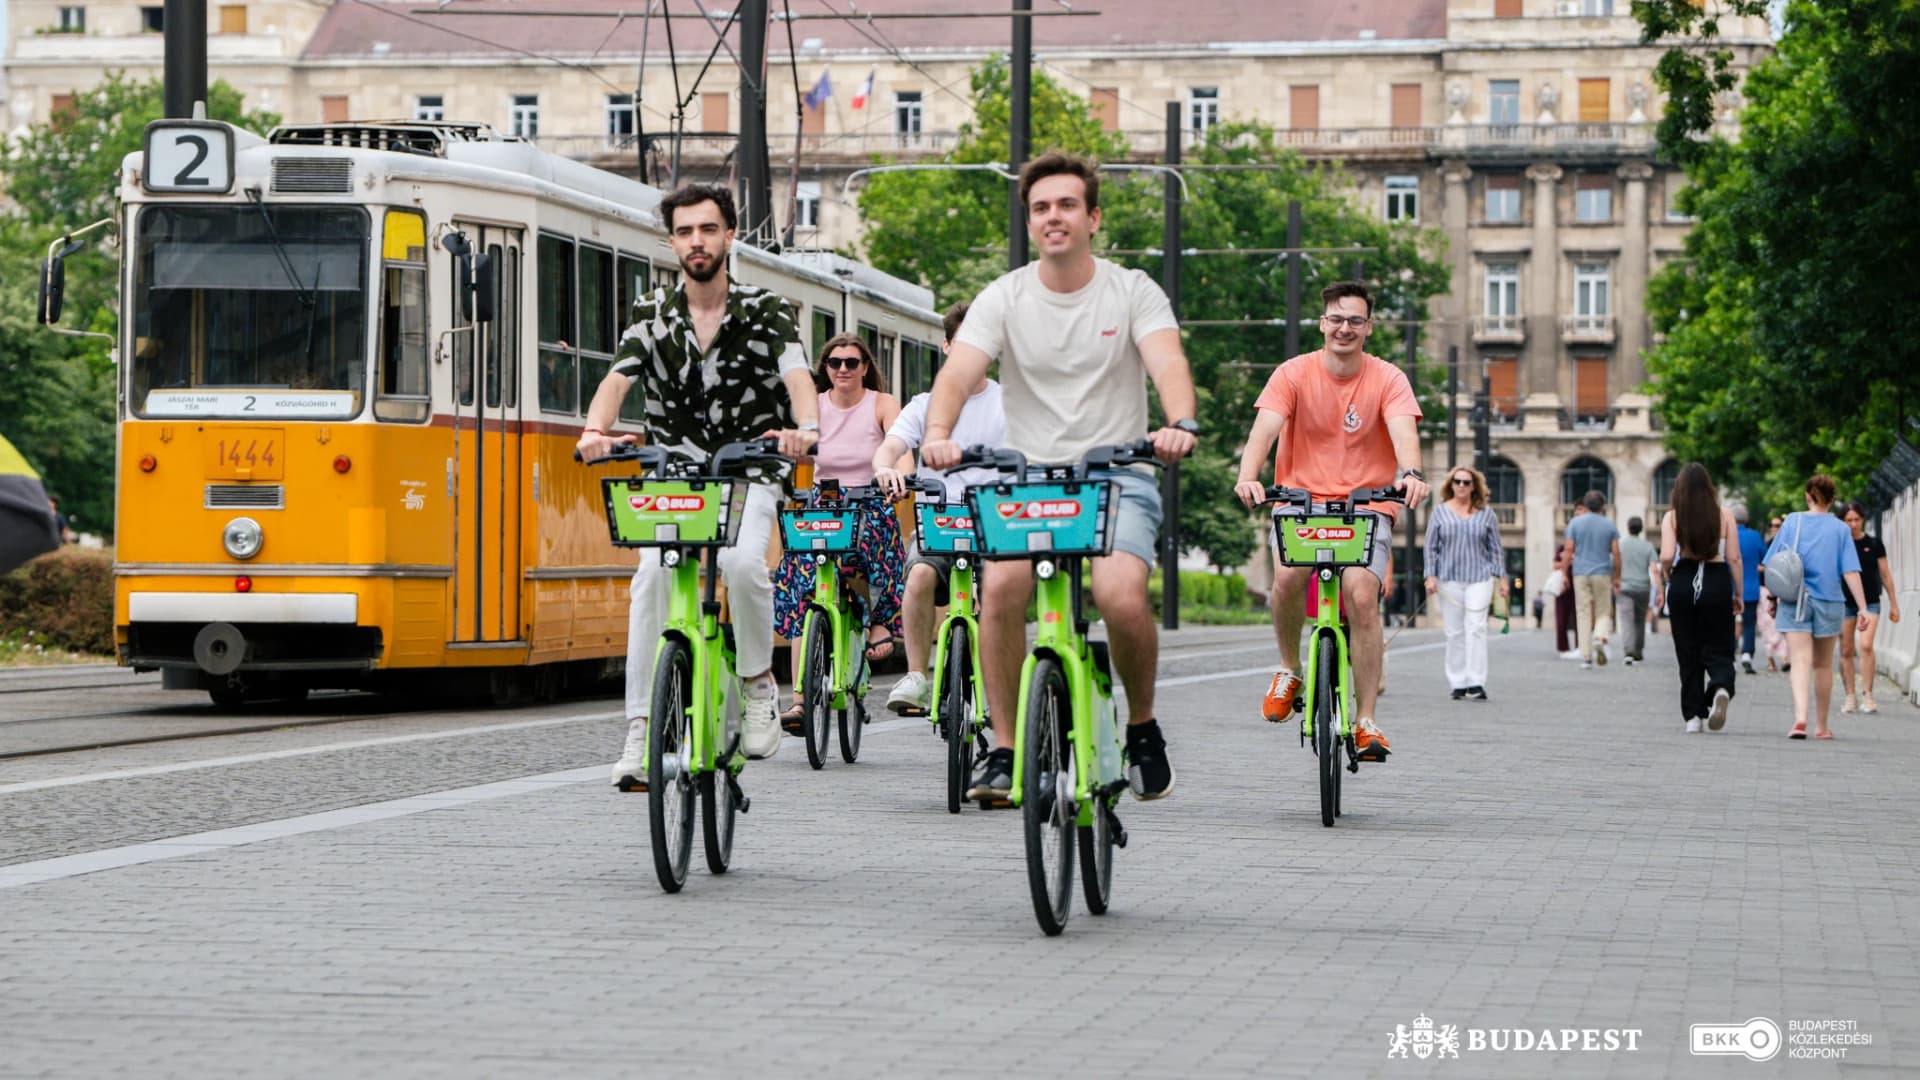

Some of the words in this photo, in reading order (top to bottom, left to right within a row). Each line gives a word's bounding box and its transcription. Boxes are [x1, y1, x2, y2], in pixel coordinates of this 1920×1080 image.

[174, 135, 209, 185] 2
[243, 395, 257, 411] 2
[218, 439, 274, 467] 1444
[670, 497, 700, 509] BUBI
[1043, 502, 1076, 515] BUBI
[821, 521, 841, 529] BUBI
[1328, 529, 1352, 538] BUBI
